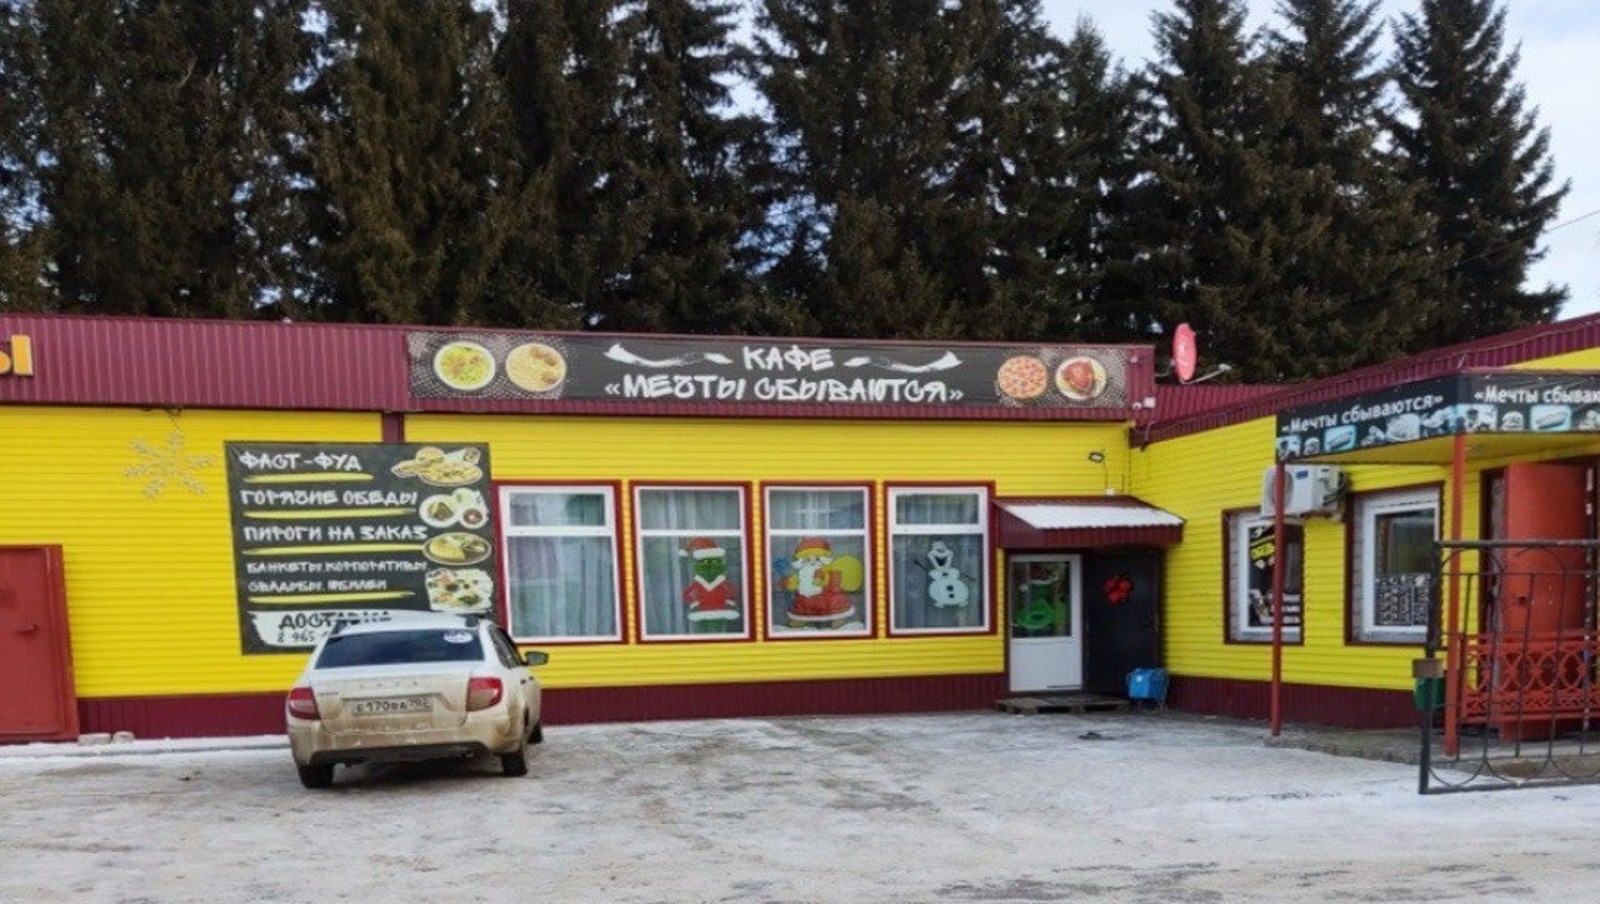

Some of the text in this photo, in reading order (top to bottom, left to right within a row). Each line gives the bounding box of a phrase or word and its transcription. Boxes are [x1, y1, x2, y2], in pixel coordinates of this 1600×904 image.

[743, 345, 834, 371] КАФЕ
[342, 490, 418, 506] ОБЕДЫ
[243, 525, 428, 541] ПИРОГИ НА ЗАКАЗ
